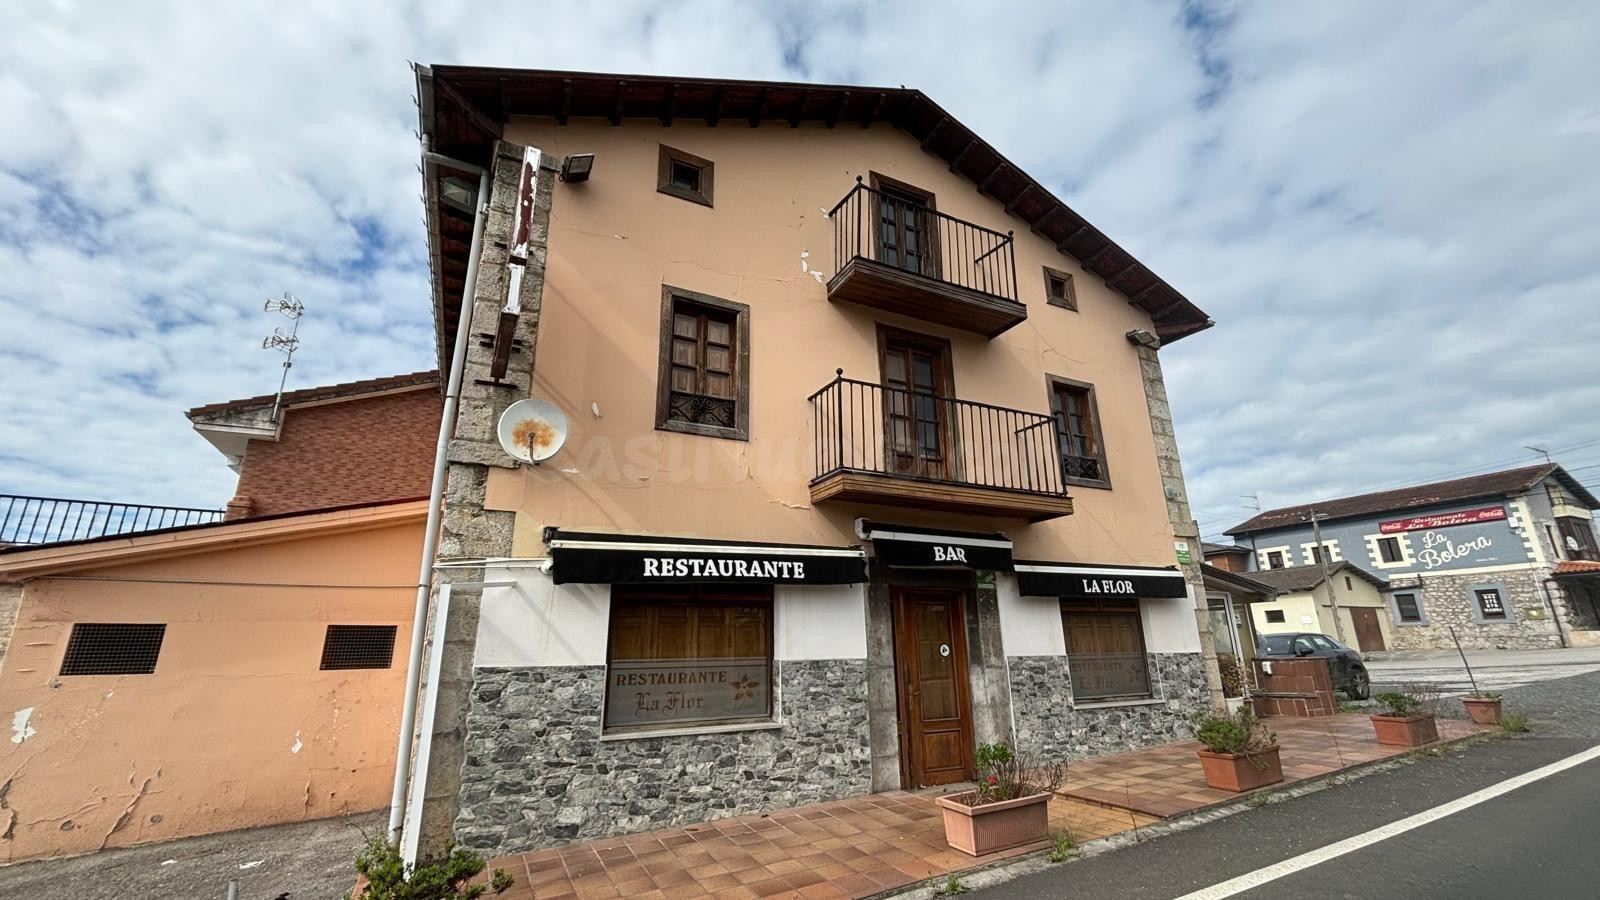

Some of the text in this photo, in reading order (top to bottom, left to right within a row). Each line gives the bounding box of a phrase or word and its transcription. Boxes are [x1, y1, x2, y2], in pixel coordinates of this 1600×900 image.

[1411, 513, 1467, 524] Restaurante
[1427, 517, 1478, 527] Bolera
[1422, 531, 1448, 549] La
[933, 546, 967, 563] BAR
[1418, 536, 1492, 569] Bolera
[643, 557, 805, 579] RESTAURANTE
[1082, 579, 1135, 594] LA FLOR
[616, 671, 727, 687] RESTAURANTE
[635, 691, 705, 718] La Flor
